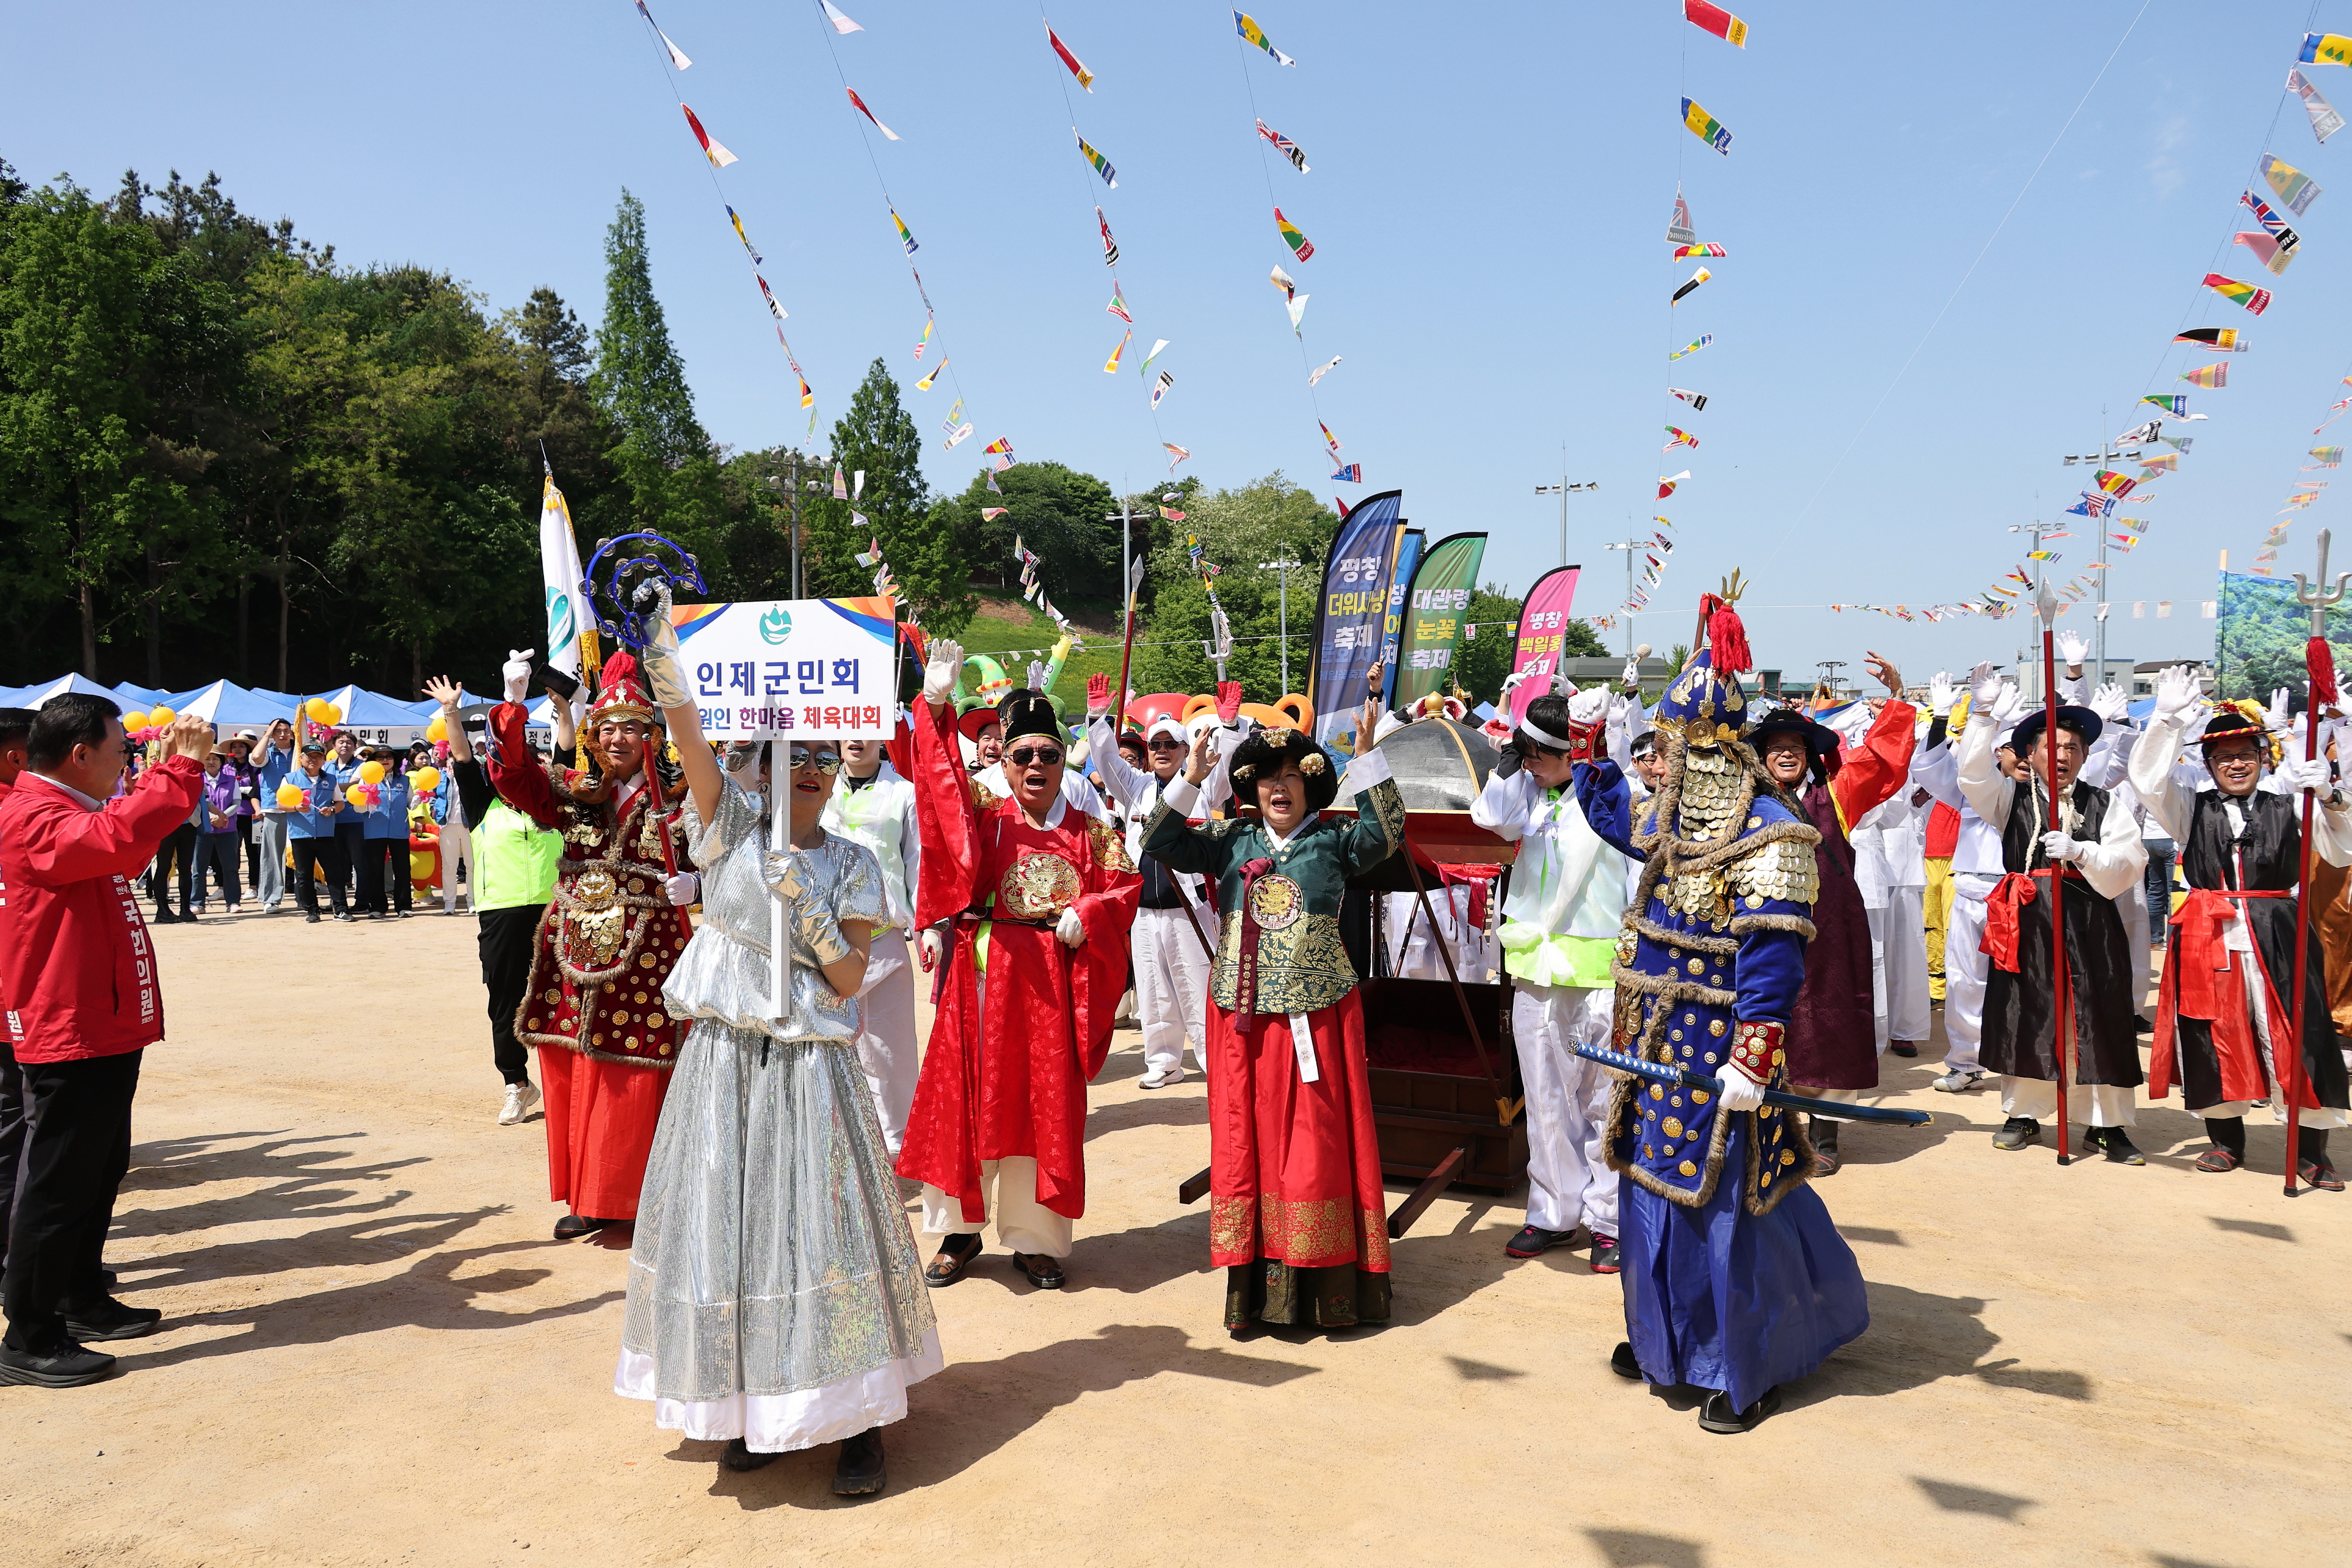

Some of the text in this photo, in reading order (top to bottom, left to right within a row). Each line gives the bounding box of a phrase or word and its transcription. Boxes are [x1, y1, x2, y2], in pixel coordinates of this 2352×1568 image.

[2115, 481, 2135, 498] Welcome
[1340, 556, 1381, 583] 평창
[1328, 589, 1386, 616] 더위사냥
[1391, 584, 1406, 606] 창
[1412, 589, 1471, 610] 대관령
[1416, 619, 1457, 640] 눈꽃
[1530, 610, 1563, 630] 평창
[1334, 624, 1373, 650] 축제
[1519, 634, 1563, 654] 백일홍
[1411, 649, 1452, 670] 축제
[1522, 658, 1551, 677] 축제
[697, 658, 859, 696] 인제군민회
[698, 706, 881, 730] 원인 한마음 체육대회
